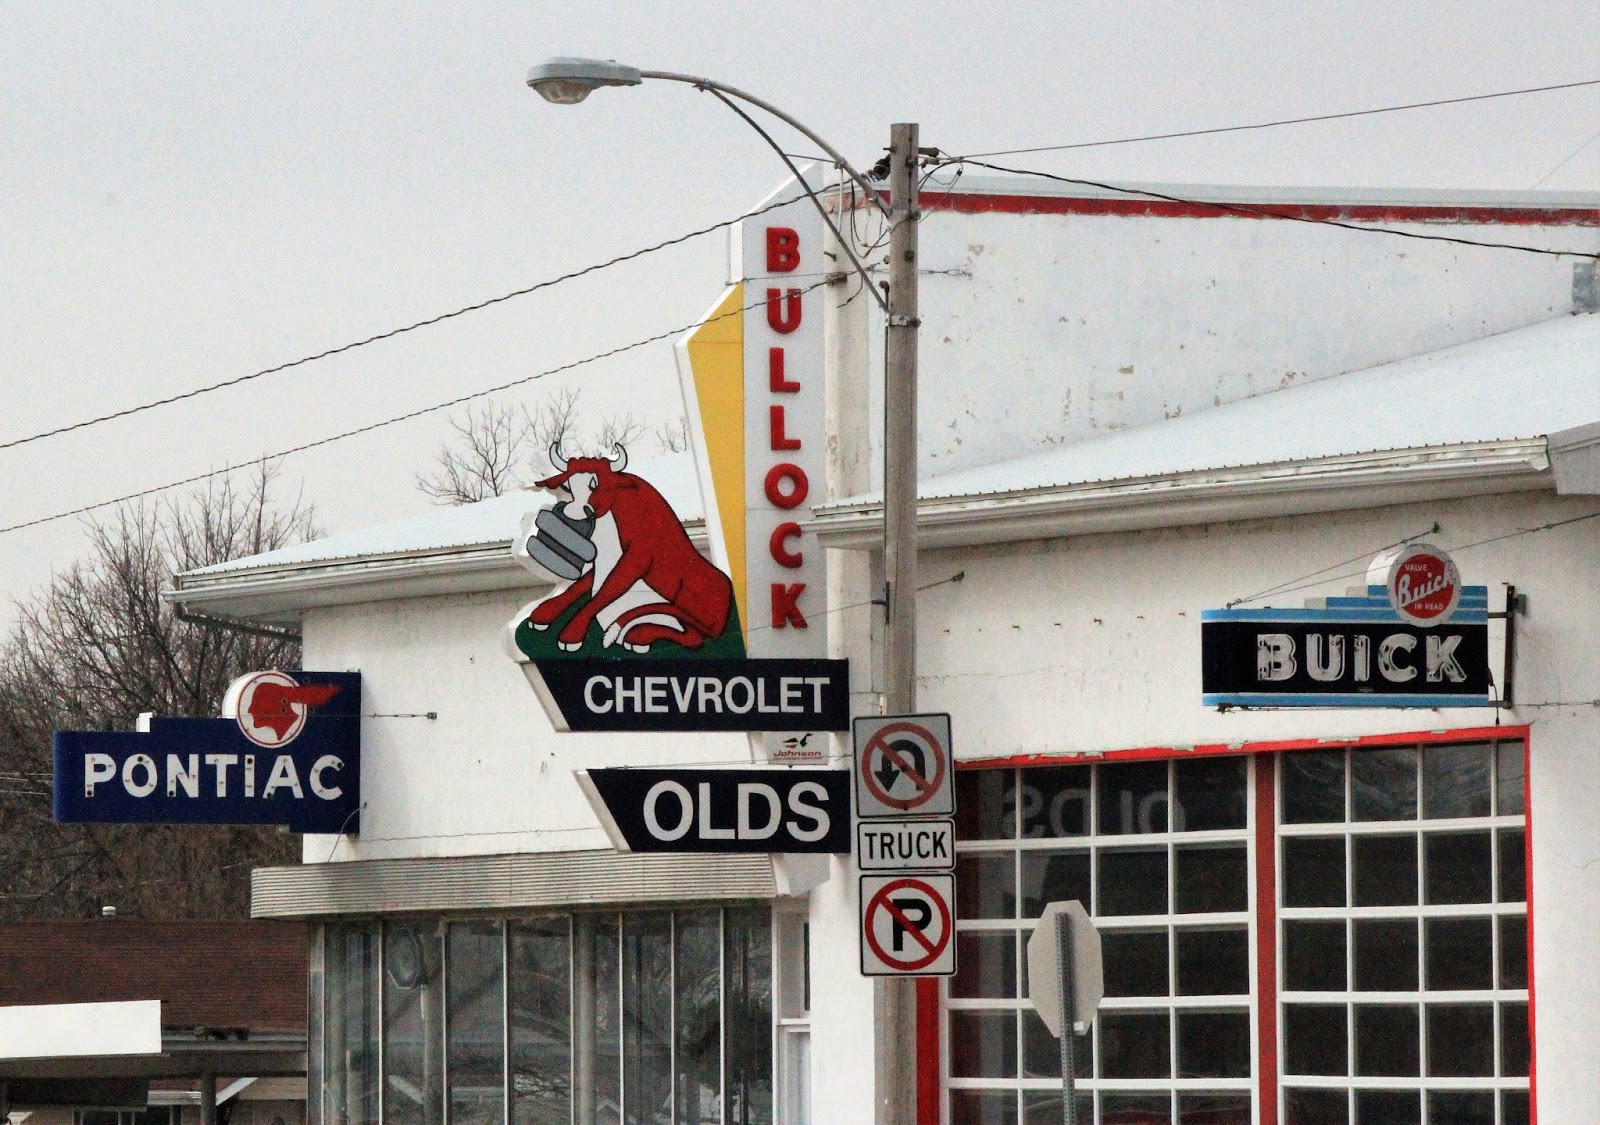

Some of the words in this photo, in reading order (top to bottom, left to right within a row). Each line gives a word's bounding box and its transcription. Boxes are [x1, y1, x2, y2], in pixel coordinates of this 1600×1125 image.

[764, 226, 809, 630] BULLOCK
[1396, 560, 1457, 611] Buick
[1405, 563, 1428, 572] VALVE
[1414, 603, 1422, 611] IN
[1424, 602, 1444, 611] HEAD
[1256, 632, 1468, 684] BUICK
[583, 675, 831, 714] CHEVROLET
[84, 752, 344, 801] PONTIAC
[642, 779, 831, 842] OLDS
[864, 830, 948, 860] TRUCK
